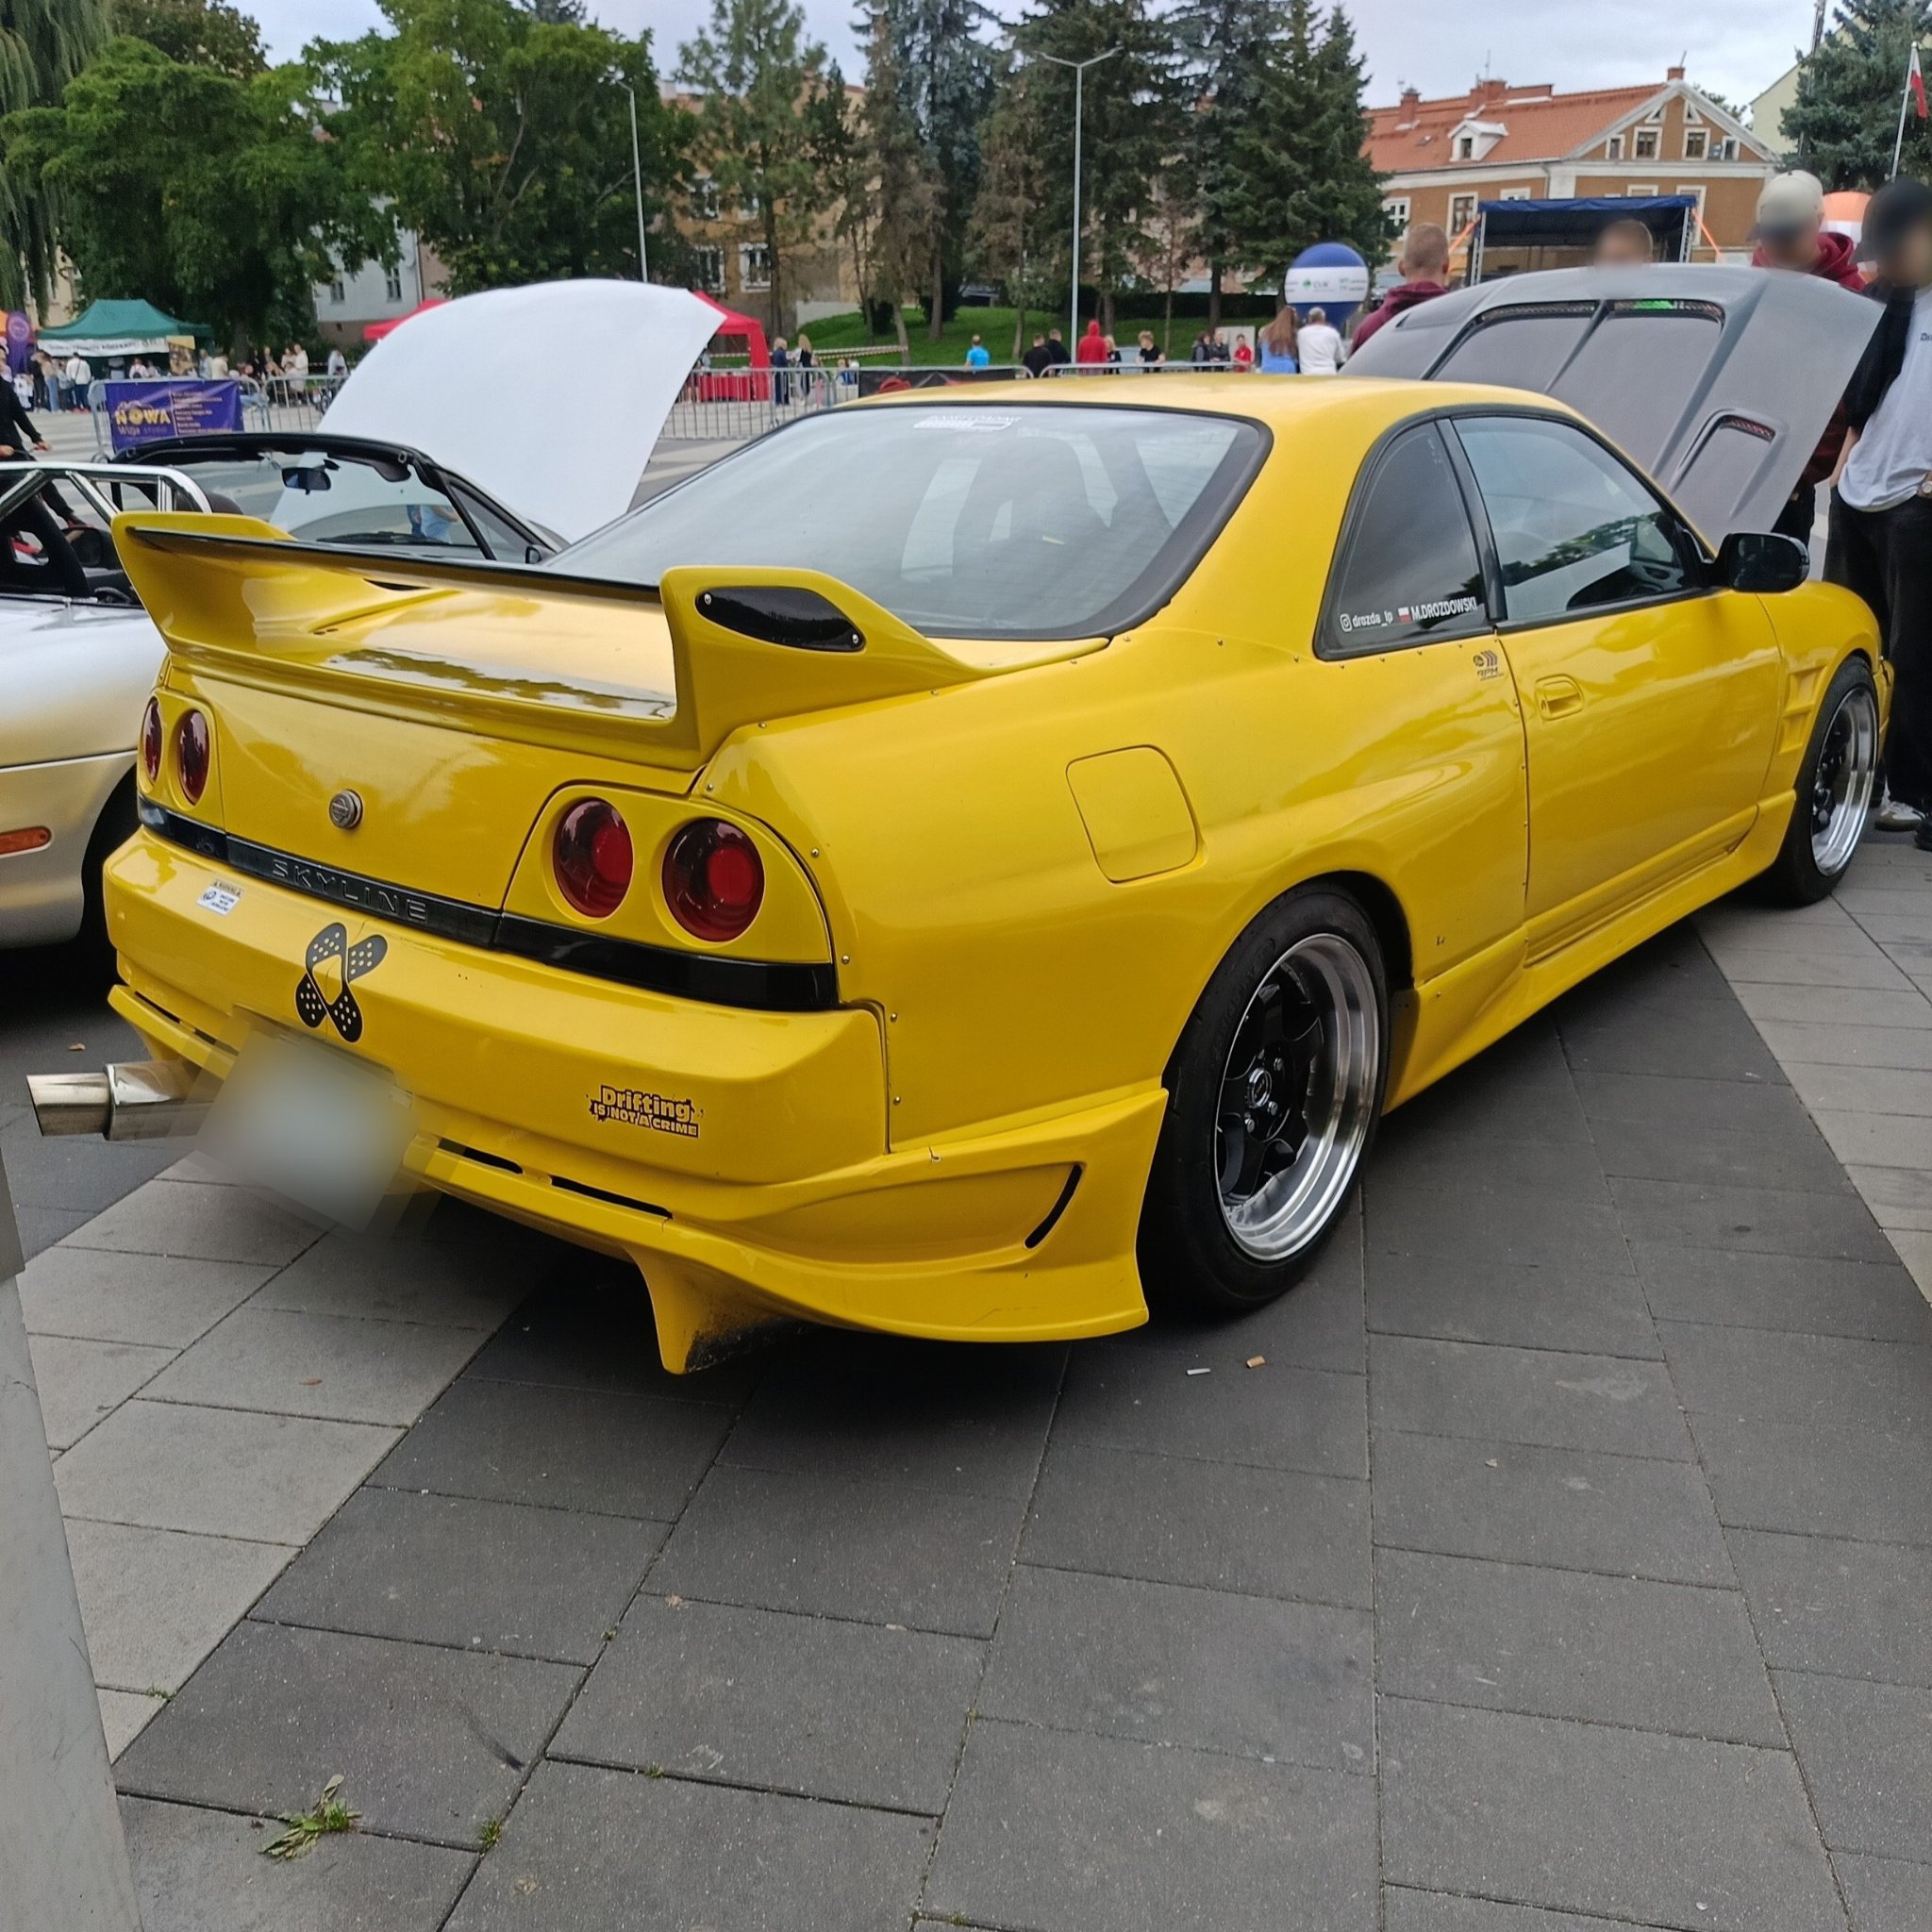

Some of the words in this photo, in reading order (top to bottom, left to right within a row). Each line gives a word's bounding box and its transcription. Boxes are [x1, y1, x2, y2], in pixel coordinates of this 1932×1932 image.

[114, 408, 171, 425] NOWA
[1410, 596, 1477, 621] M.DROZDOWSKI
[272, 858, 427, 922] SKYLINE
[593, 1102, 606, 1116] IS
[610, 1107, 637, 1123] NOT
[639, 1114, 650, 1127] A
[652, 1118, 698, 1136] CRIME
[602, 1087, 691, 1123] Drifting
